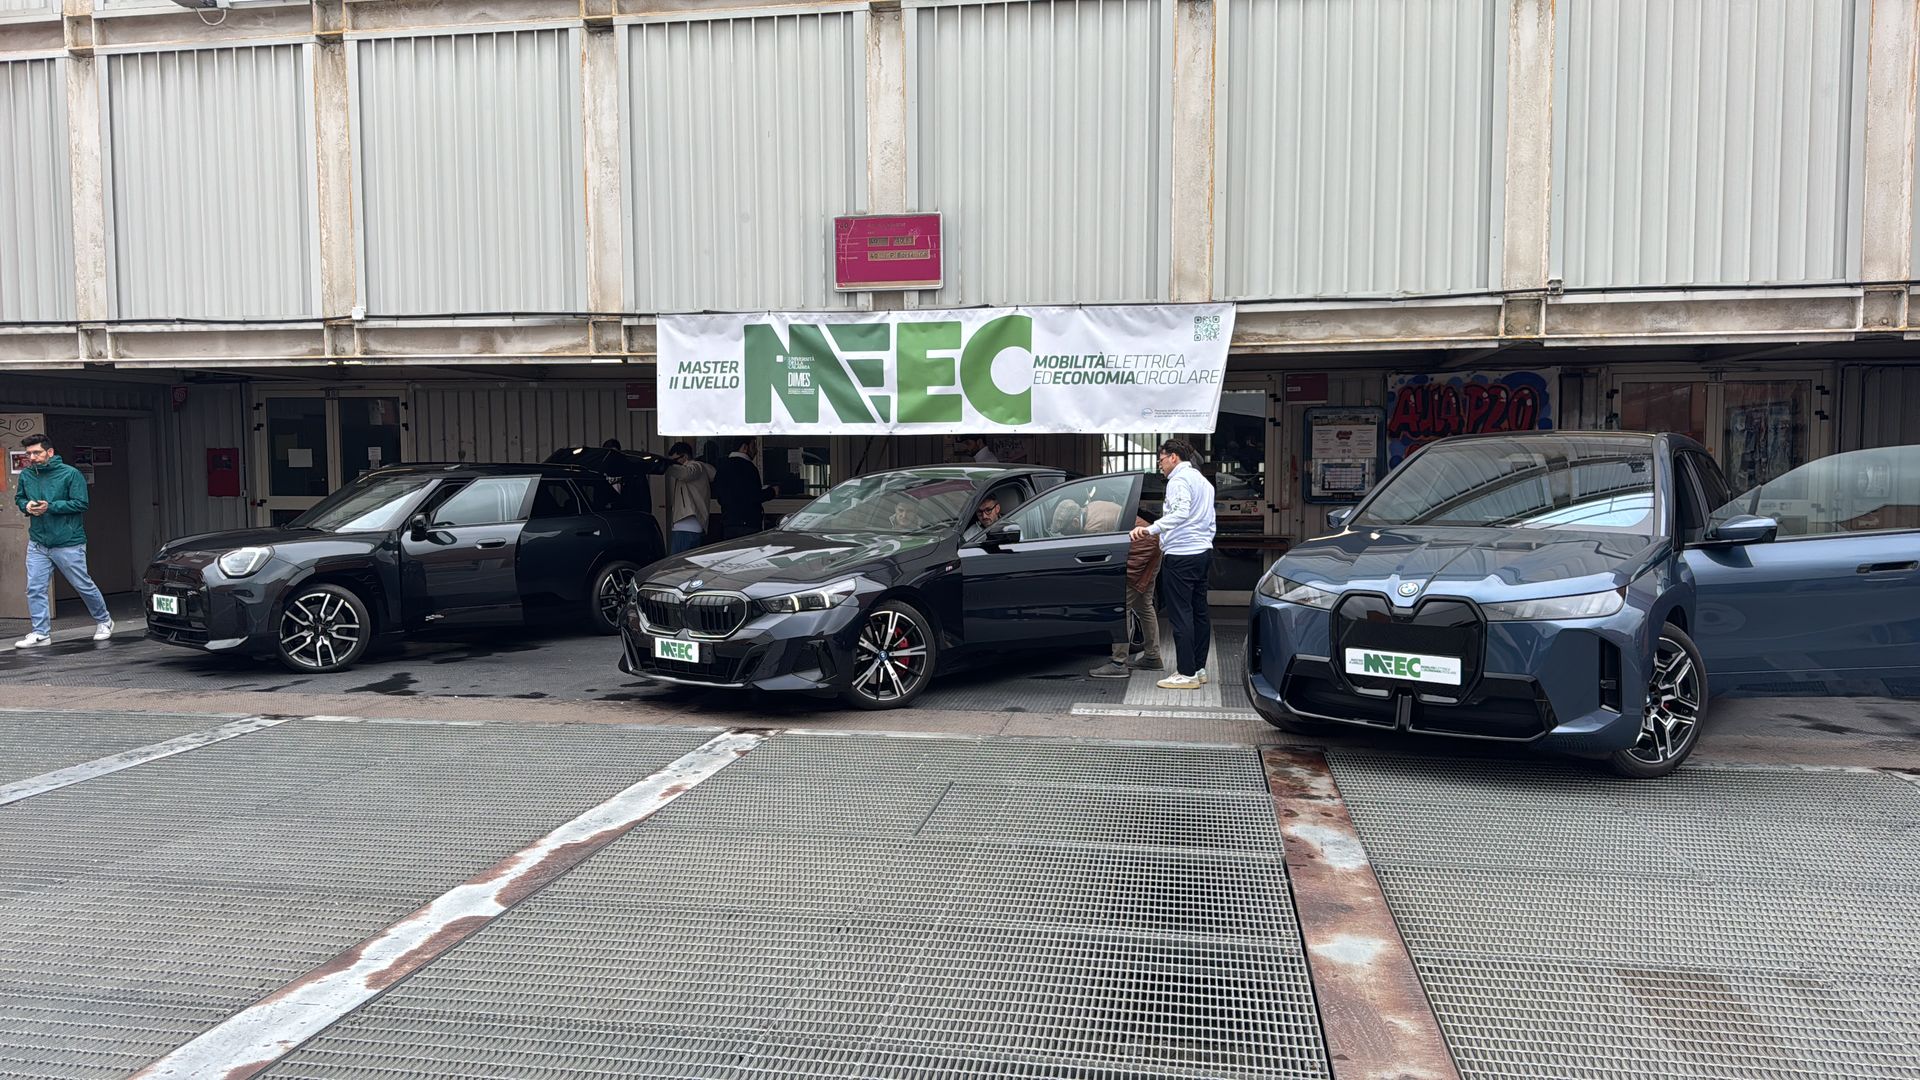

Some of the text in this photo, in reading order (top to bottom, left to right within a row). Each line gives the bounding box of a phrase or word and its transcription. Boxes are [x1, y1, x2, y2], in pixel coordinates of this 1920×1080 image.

[678, 360, 739, 374] MASTER
[669, 375, 740, 389] II LIVELLO
